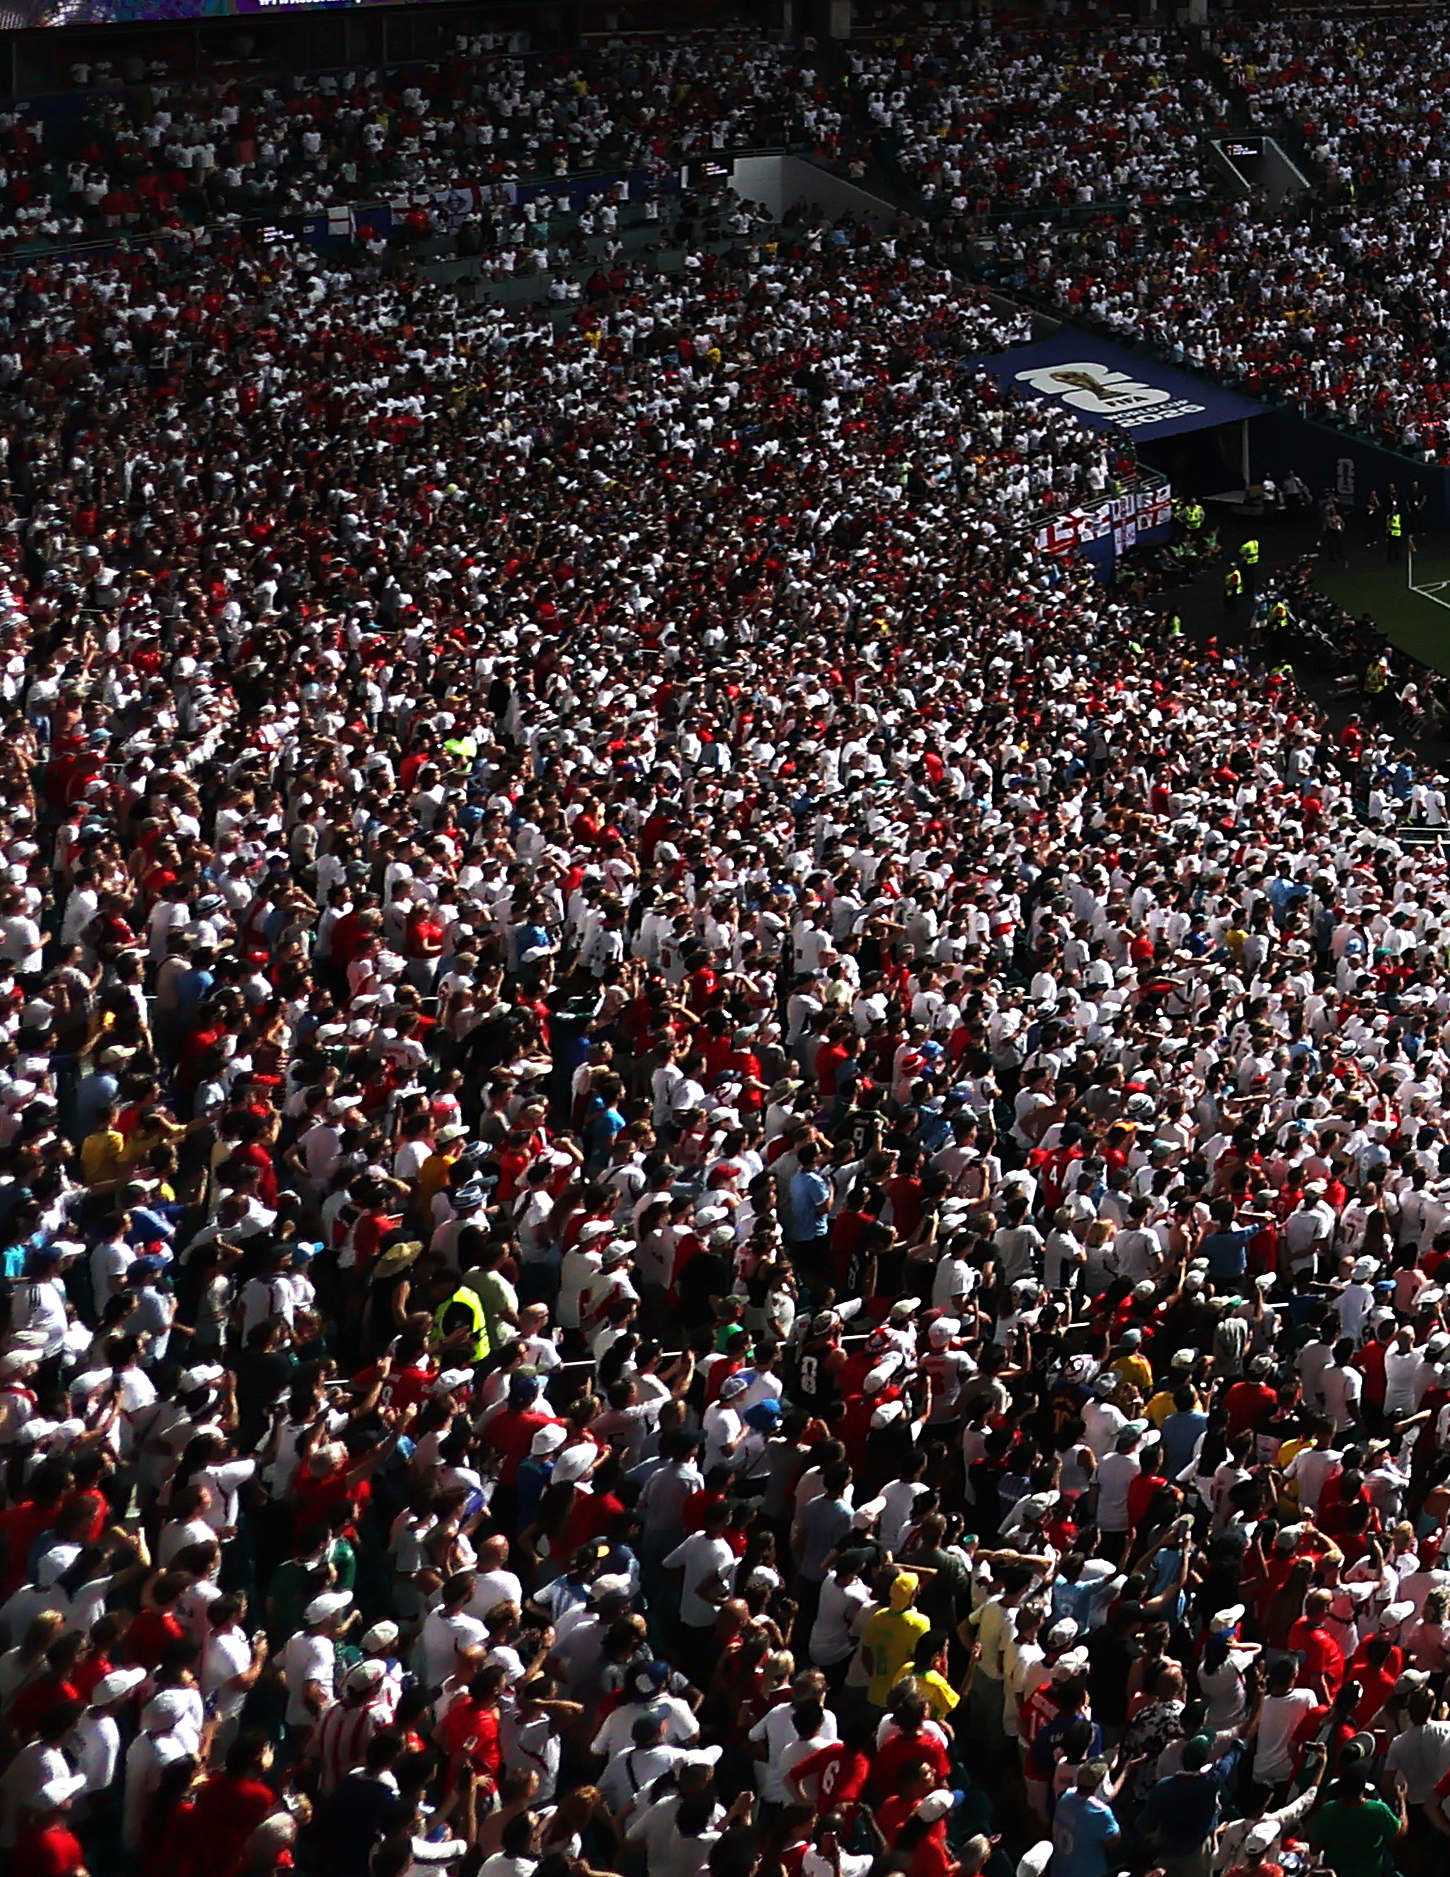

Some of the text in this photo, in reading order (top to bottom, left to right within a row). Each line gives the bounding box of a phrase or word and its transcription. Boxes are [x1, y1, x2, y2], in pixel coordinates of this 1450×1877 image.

[1105, 395, 1149, 407] FIFA
[1114, 404, 1206, 429] 2026
[852, 1126, 865, 1150] 9
[1050, 1165, 1057, 1185] 4
[1346, 1223, 1356, 1244] 7
[801, 1356, 817, 1394] 8
[822, 1760, 840, 1794] 6
